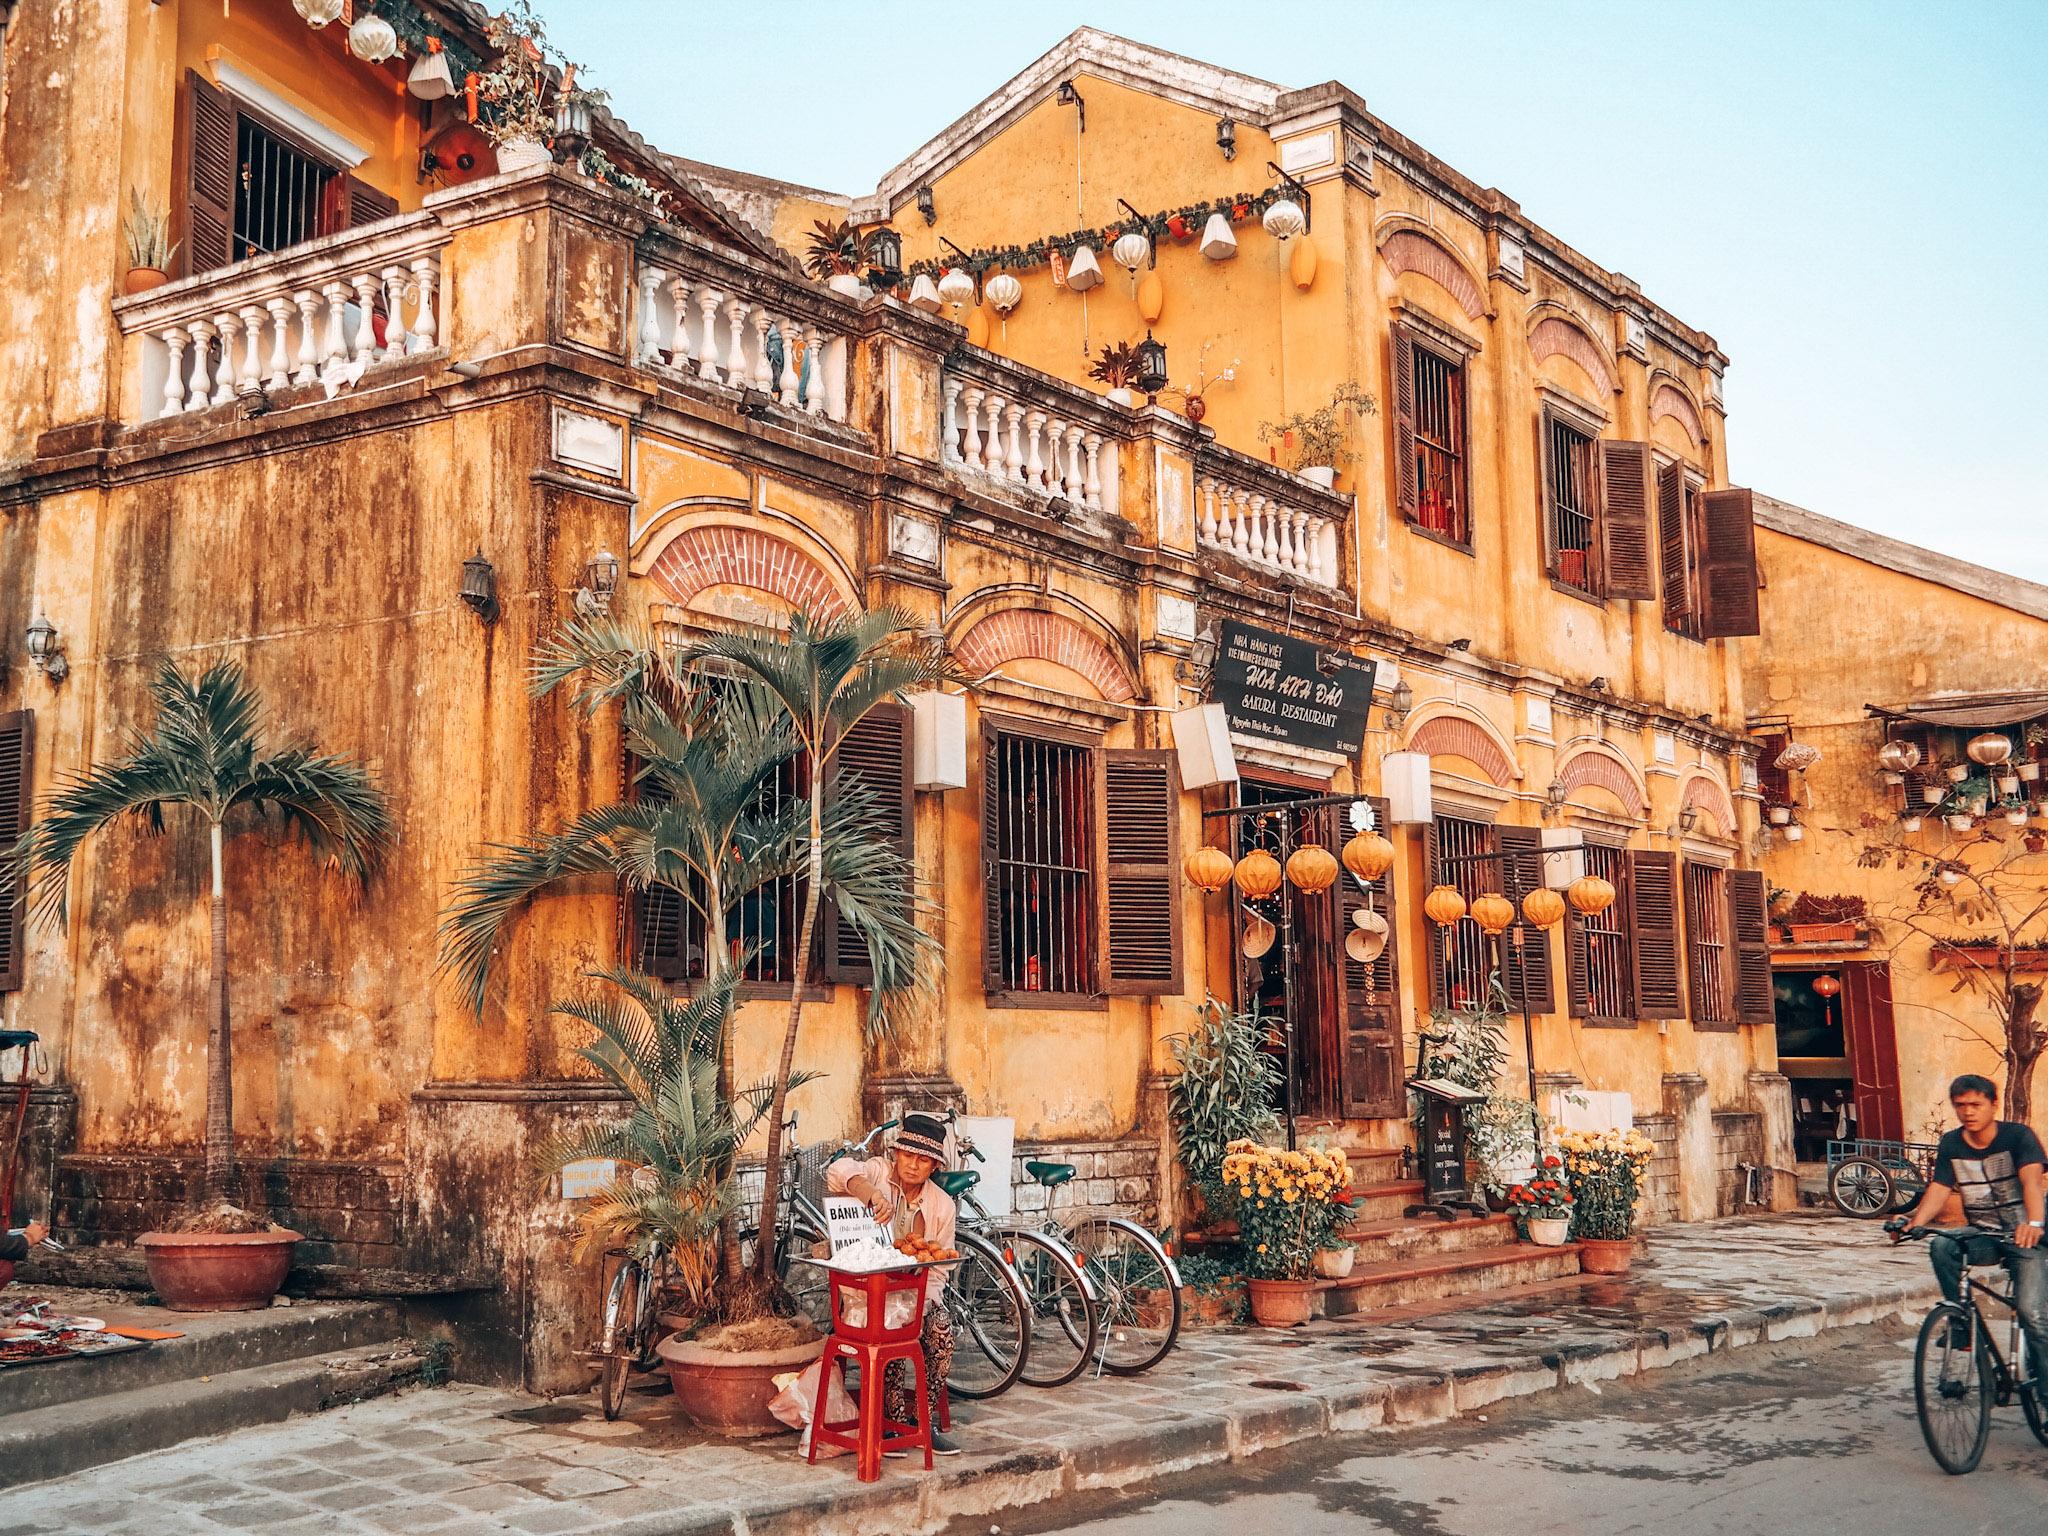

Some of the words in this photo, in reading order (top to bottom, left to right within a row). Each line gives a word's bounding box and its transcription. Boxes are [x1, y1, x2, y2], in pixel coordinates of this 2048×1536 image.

[1233, 634, 1248, 648] NHÀ
[1250, 638, 1268, 653] HÀNG
[1268, 644, 1283, 658] VIỆT
[1246, 665, 1277, 691] HOA
[1277, 674, 1313, 700] ANH
[1315, 681, 1343, 707] ĐÀO
[1241, 694, 1277, 715] SAKURA
[1280, 703, 1338, 728] RESTAURANT
[830, 1204, 859, 1220] BÁNH
